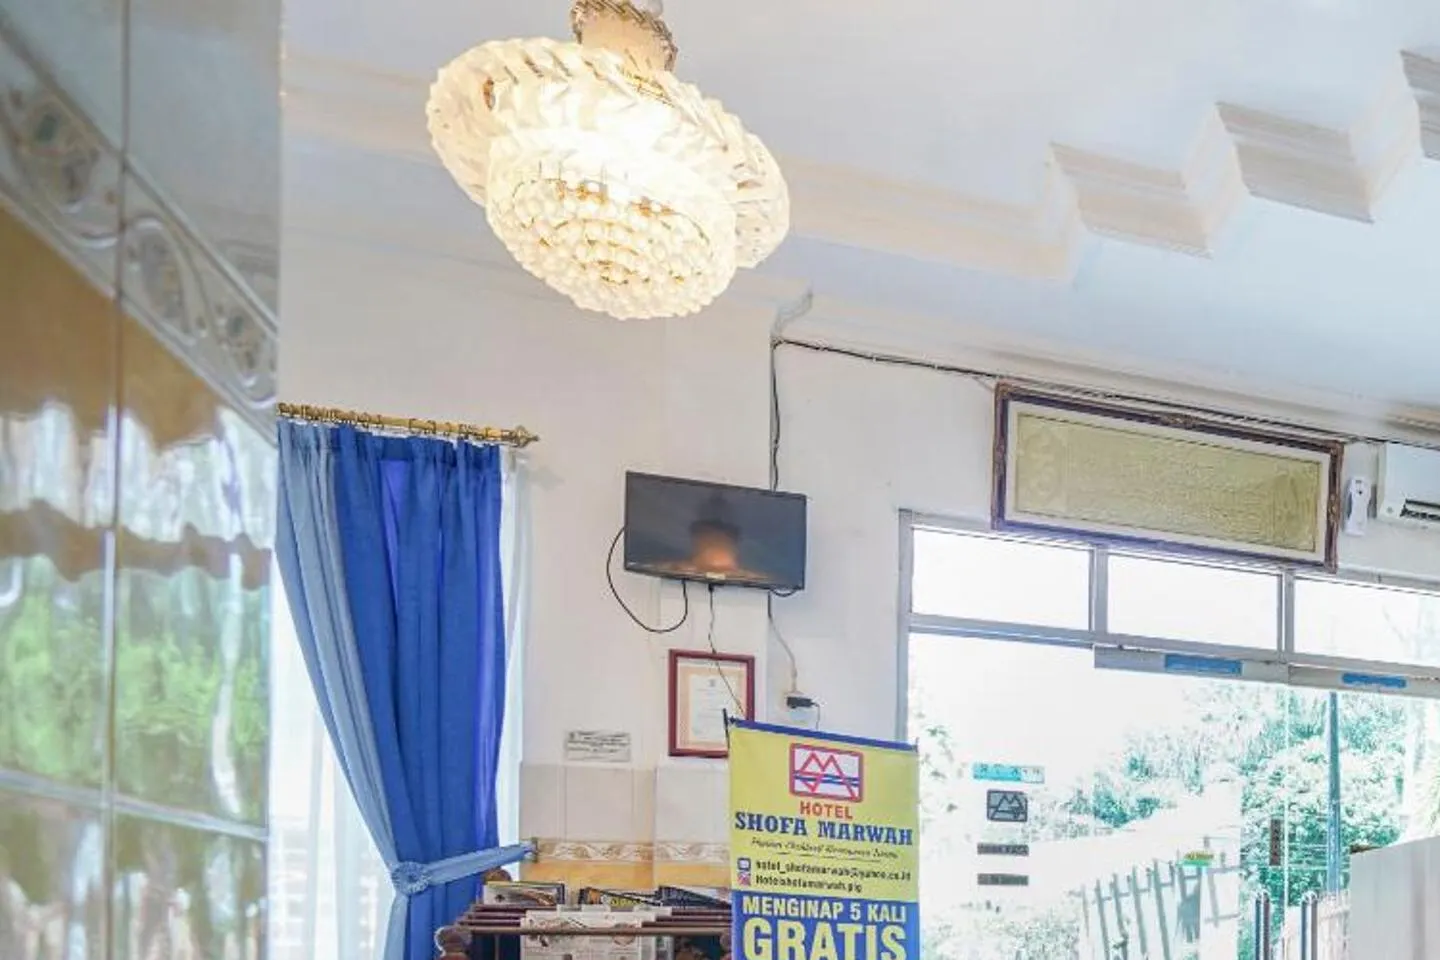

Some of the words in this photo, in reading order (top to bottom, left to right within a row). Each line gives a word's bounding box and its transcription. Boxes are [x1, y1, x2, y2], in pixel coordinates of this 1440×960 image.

[800, 801, 853, 820] HOTEL
[735, 812, 808, 837] SHOFA
[818, 820, 913, 846] MARWAH
[742, 896, 844, 919] MENGINAP
[850, 902, 861, 921] 5
[867, 903, 907, 923] KALI
